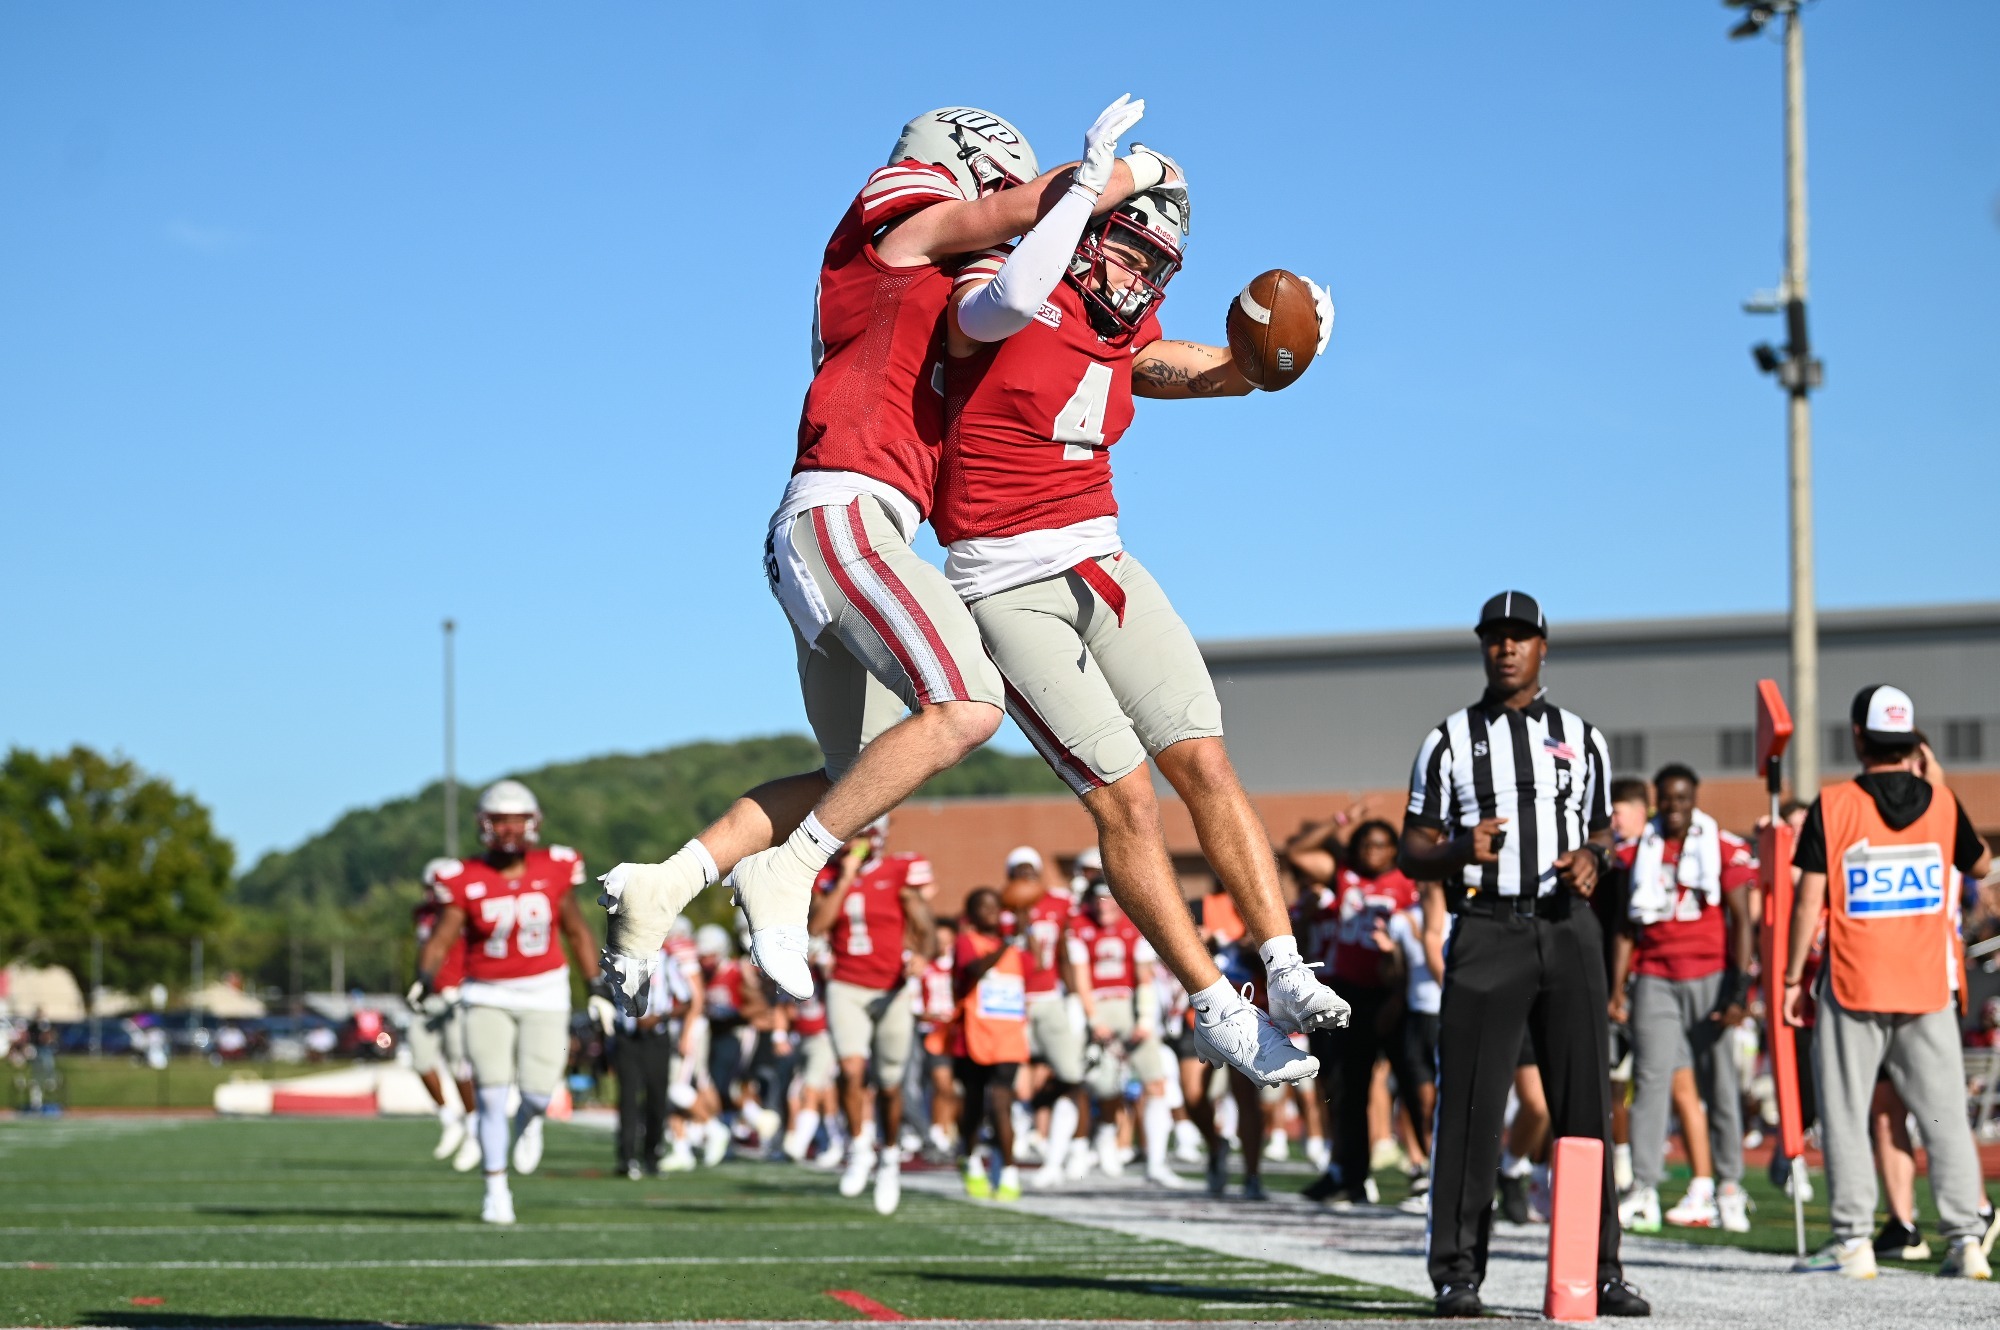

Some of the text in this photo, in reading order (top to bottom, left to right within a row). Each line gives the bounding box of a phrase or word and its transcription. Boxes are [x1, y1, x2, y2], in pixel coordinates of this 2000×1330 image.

[936, 109, 1019, 144] IUP
[1277, 347, 1294, 372] IUP
[1051, 361, 1113, 461] 4
[1473, 740, 1488, 757] S
[1847, 864, 1941, 895] PSAC
[480, 890, 552, 959] 78
[843, 891, 873, 956] 1
[1094, 936, 1127, 981] 2
